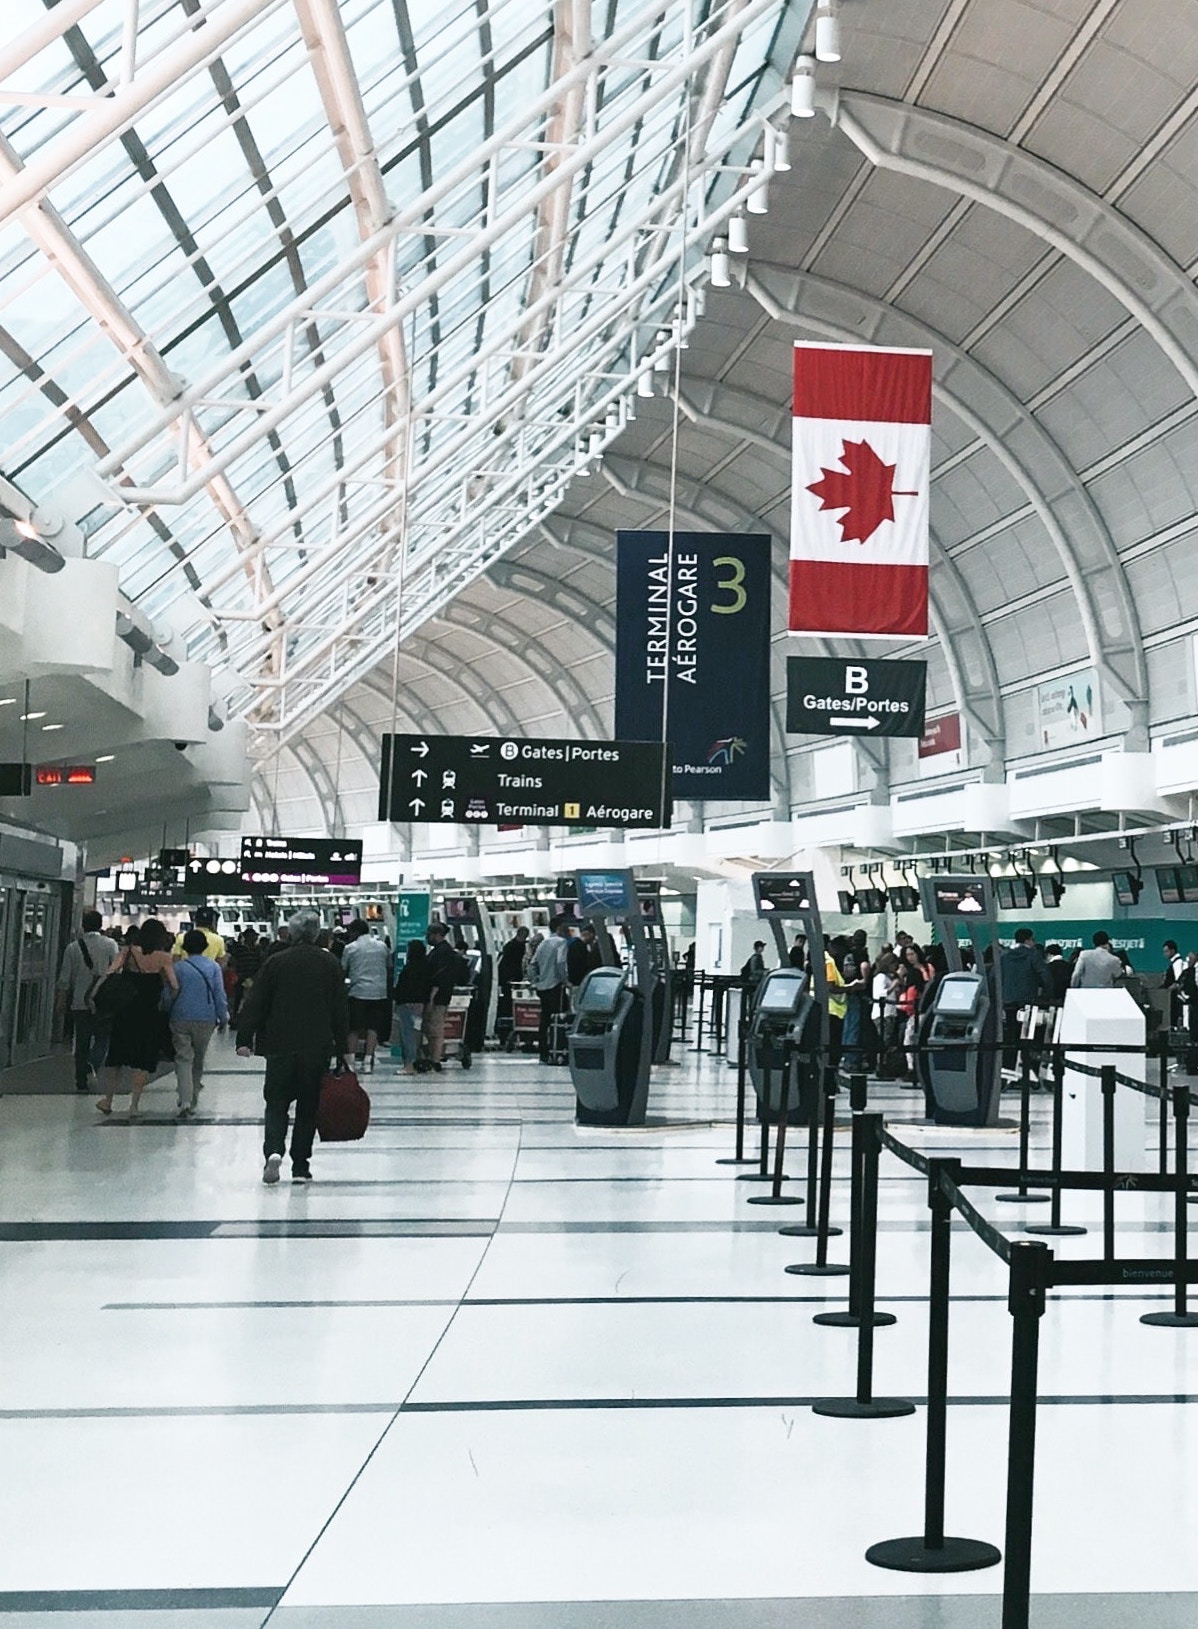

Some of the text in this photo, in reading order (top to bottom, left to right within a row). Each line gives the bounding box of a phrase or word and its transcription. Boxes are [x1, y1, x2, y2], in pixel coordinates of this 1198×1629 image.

[710, 556, 748, 615] 3
[646, 552, 668, 684] TERMINAL
[672, 553, 698, 684] AÉROGARE
[845, 665, 869, 694] B
[803, 694, 909, 713] Gates/Portes
[684, 764, 722, 774] Pearson
[497, 773, 543, 788] Trains
[496, 802, 559, 818] Terminal
[586, 804, 654, 822] Aérogare
[1122, 1267, 1173, 1278] bienvenue
